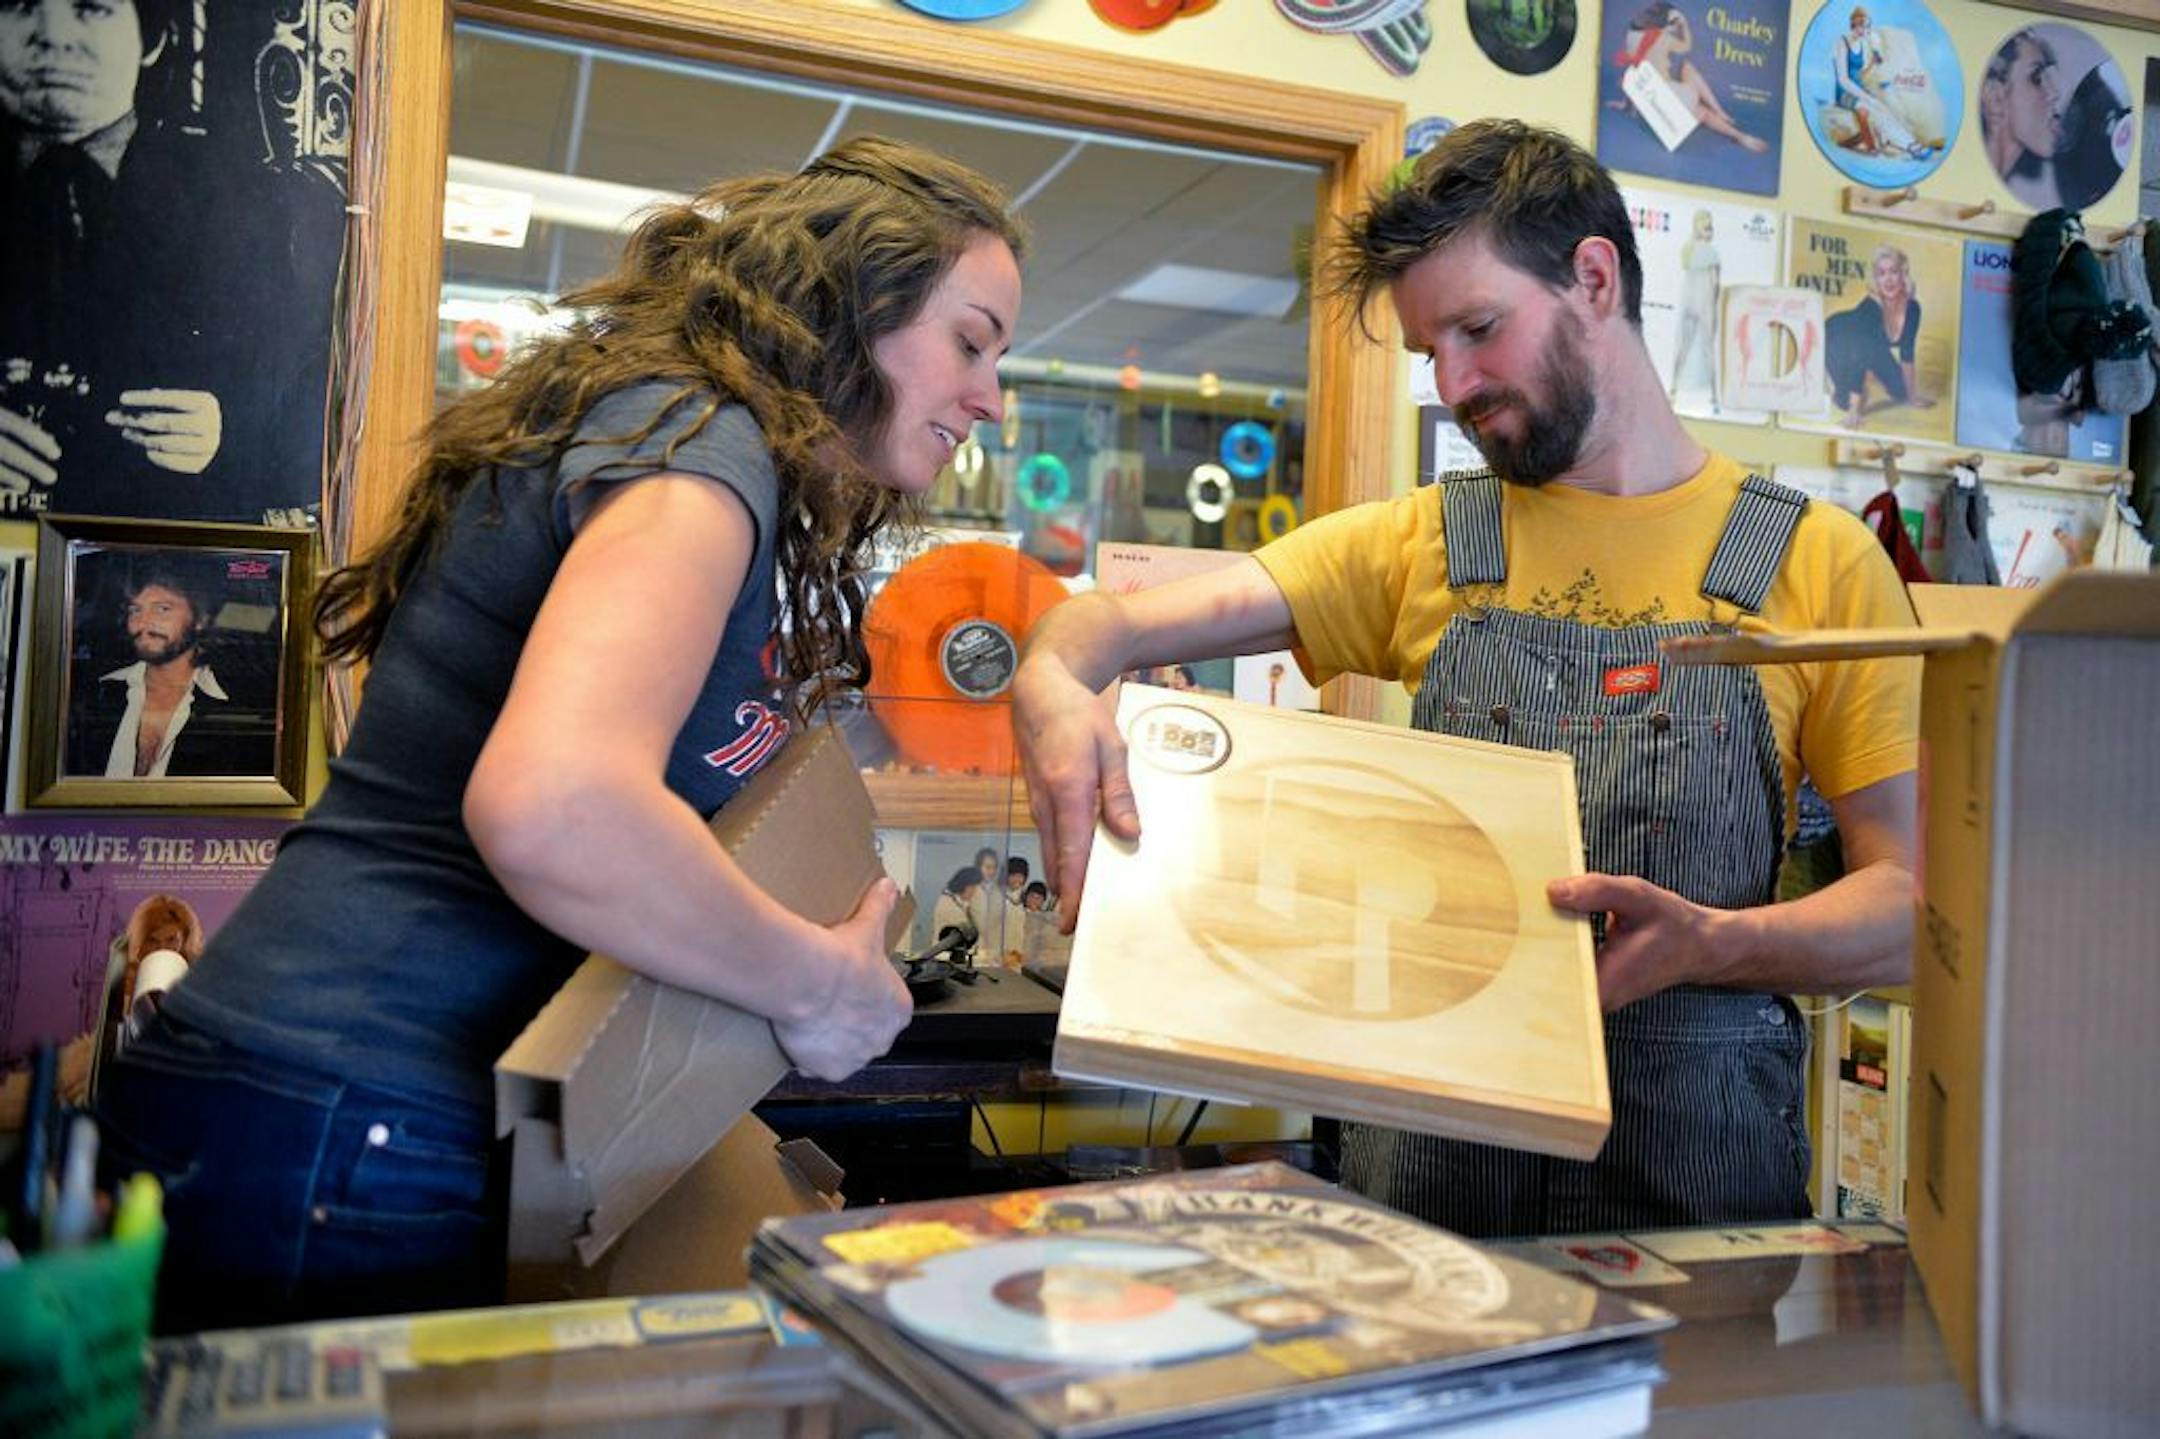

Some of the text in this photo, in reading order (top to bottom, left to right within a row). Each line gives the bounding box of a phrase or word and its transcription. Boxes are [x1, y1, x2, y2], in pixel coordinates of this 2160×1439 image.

[1706, 6, 1776, 46] Charley
[1811, 233, 1848, 256] FOR
[1826, 255, 1866, 280] MEN
[1796, 274, 1846, 297] ONLY
[0, 835, 44, 864] MY
[138, 838, 196, 866] THE
